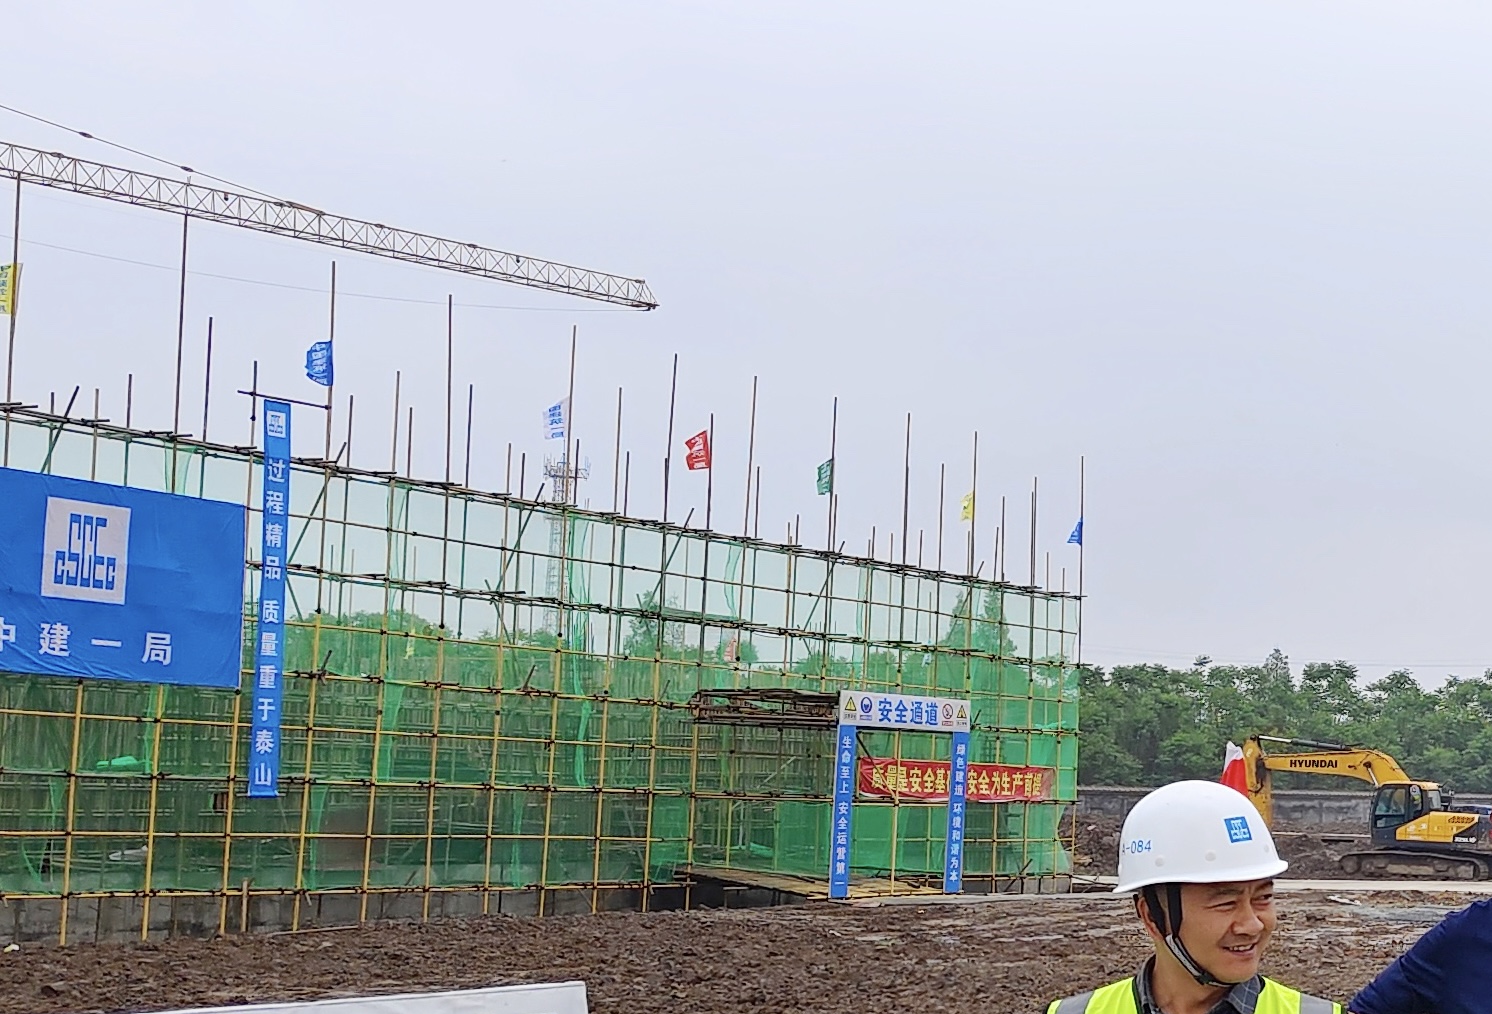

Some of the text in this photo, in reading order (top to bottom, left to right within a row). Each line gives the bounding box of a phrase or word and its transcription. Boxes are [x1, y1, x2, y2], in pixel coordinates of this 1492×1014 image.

[264, 458, 286, 580] 过程精品
[254, 600, 280, 786] 质量重于泰山
[878, 698, 939, 726] 安全通道
[839, 736, 852, 794] 生命至上
[872, 764, 950, 794] 质量是安全基
[1289, 759, 1338, 769] HYUNDAI
